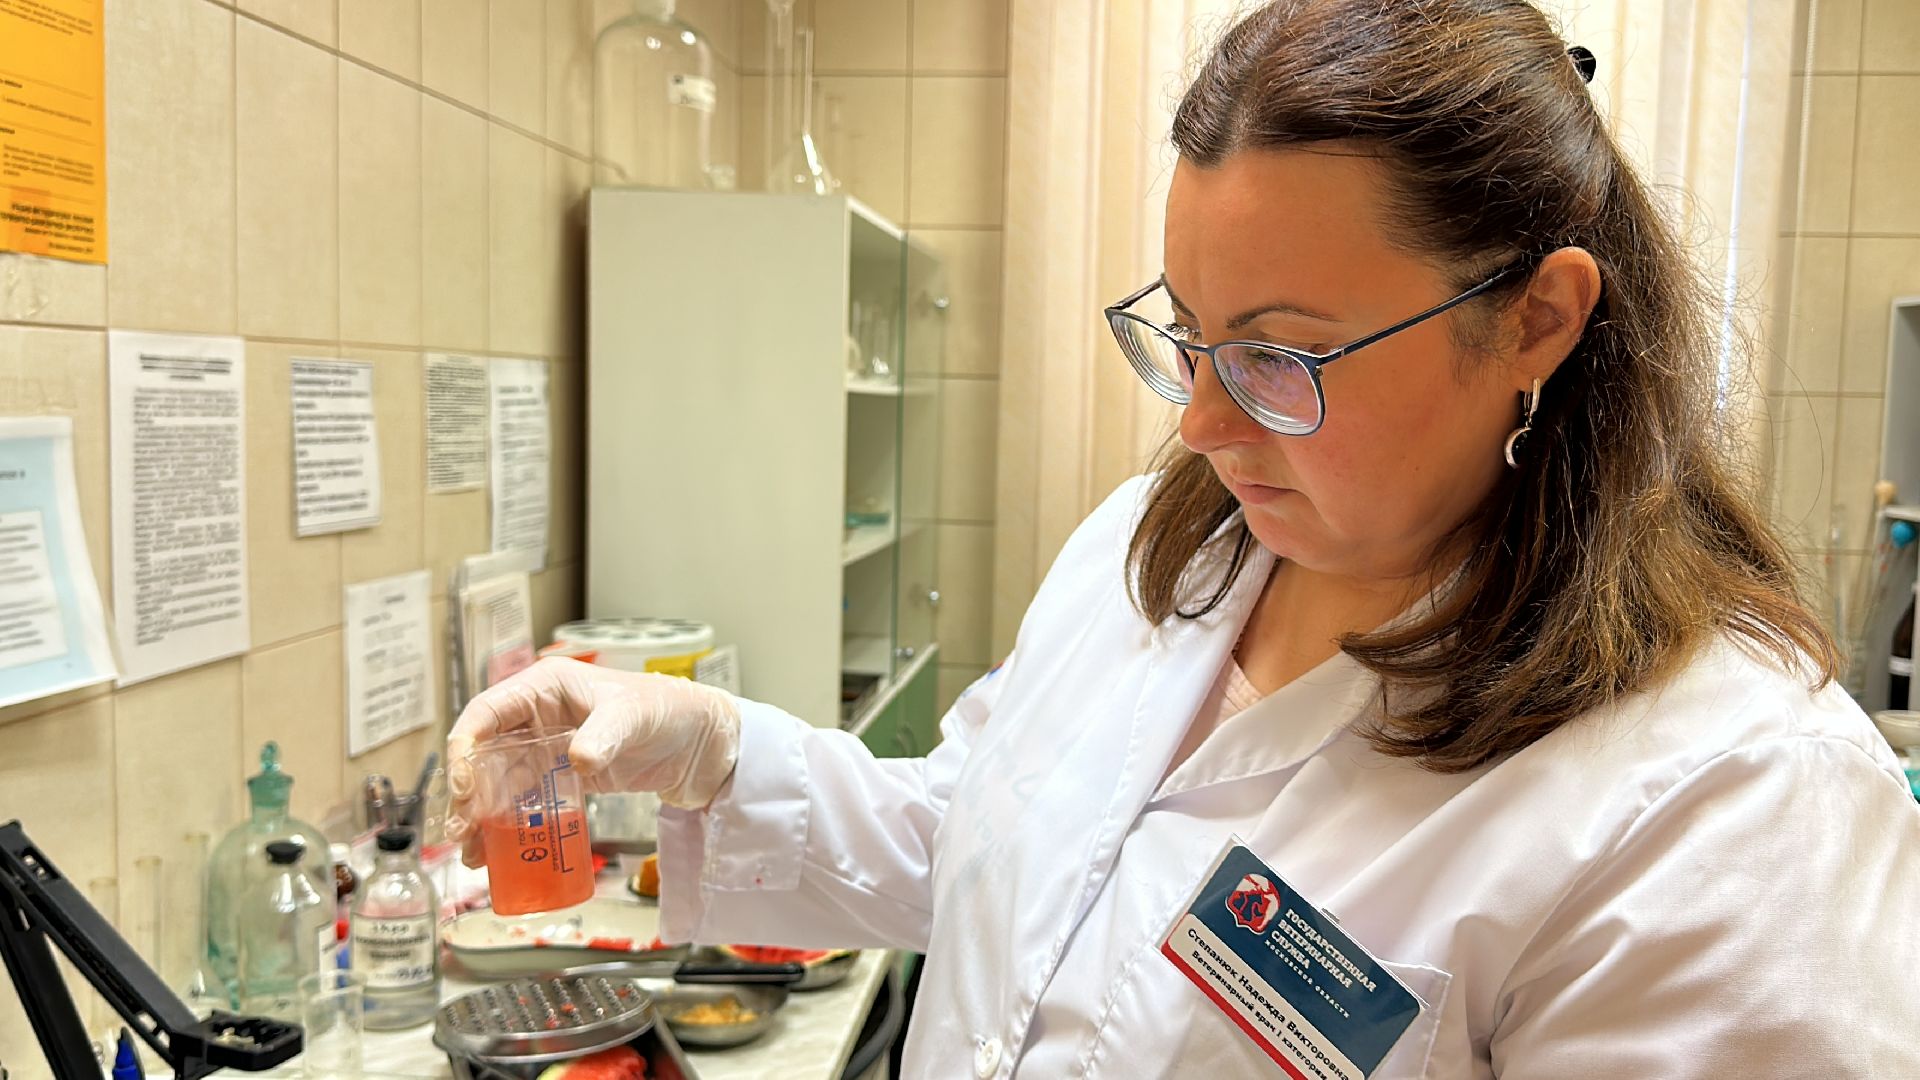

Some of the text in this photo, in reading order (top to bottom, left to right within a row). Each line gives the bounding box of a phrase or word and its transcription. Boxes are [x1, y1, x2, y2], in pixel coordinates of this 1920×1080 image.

[567, 820, 579, 831] 50
[1264, 939, 1350, 1019] МОСКОВСКОЙ ОБЛАСТИ
[1271, 930, 1311, 970] СЛУЖБА
[1278, 919, 1353, 989] ВЕТЕРИНАРНАЯ
[1285, 908, 1377, 993] ГОСУДАРСТВЕННАЯ
[1188, 928, 1350, 1080] Степанюк Надежда Викторовна
[1191, 950, 1255, 1012] Ветеринарный
[1255, 1011, 1277, 1033] врач
[1282, 1036, 1328, 1080] категории
